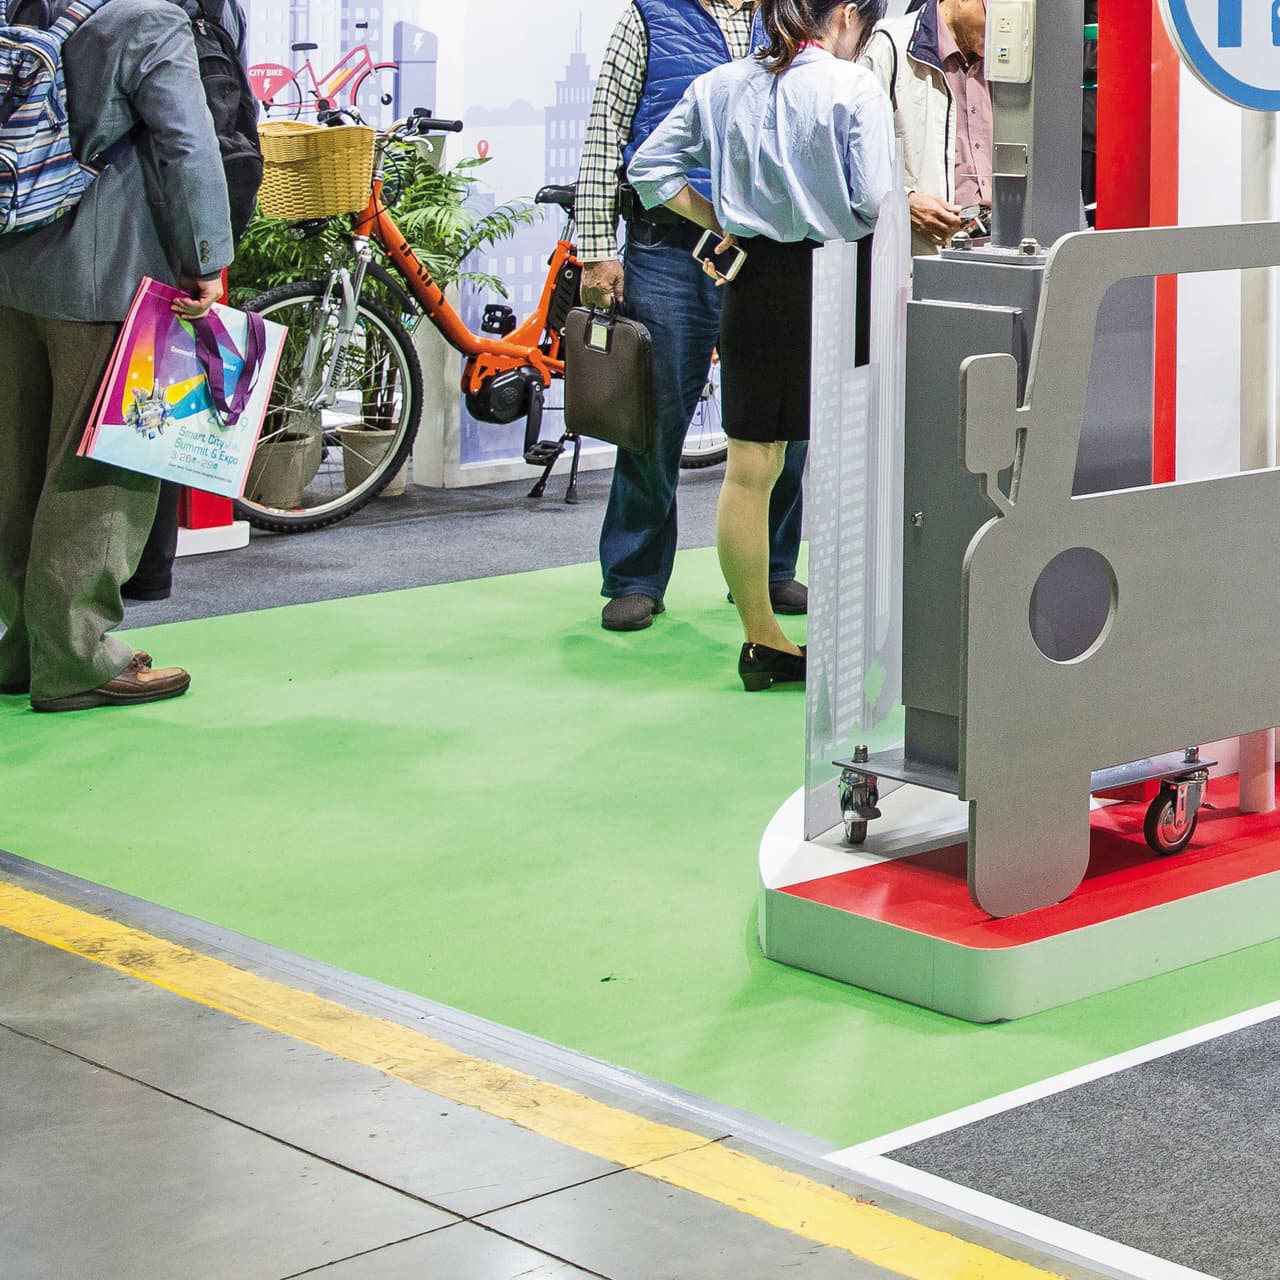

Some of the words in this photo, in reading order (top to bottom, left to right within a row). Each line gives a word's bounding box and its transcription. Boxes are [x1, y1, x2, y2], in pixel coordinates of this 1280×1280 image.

[250, 69, 265, 77] CITY
[266, 69, 284, 77] BIKE
[330, 346, 348, 389] SPINNER
[179, 425, 206, 443] Smart
[208, 434, 224, 450] City
[174, 437, 208, 456] Summit
[219, 450, 239, 465] Expo
